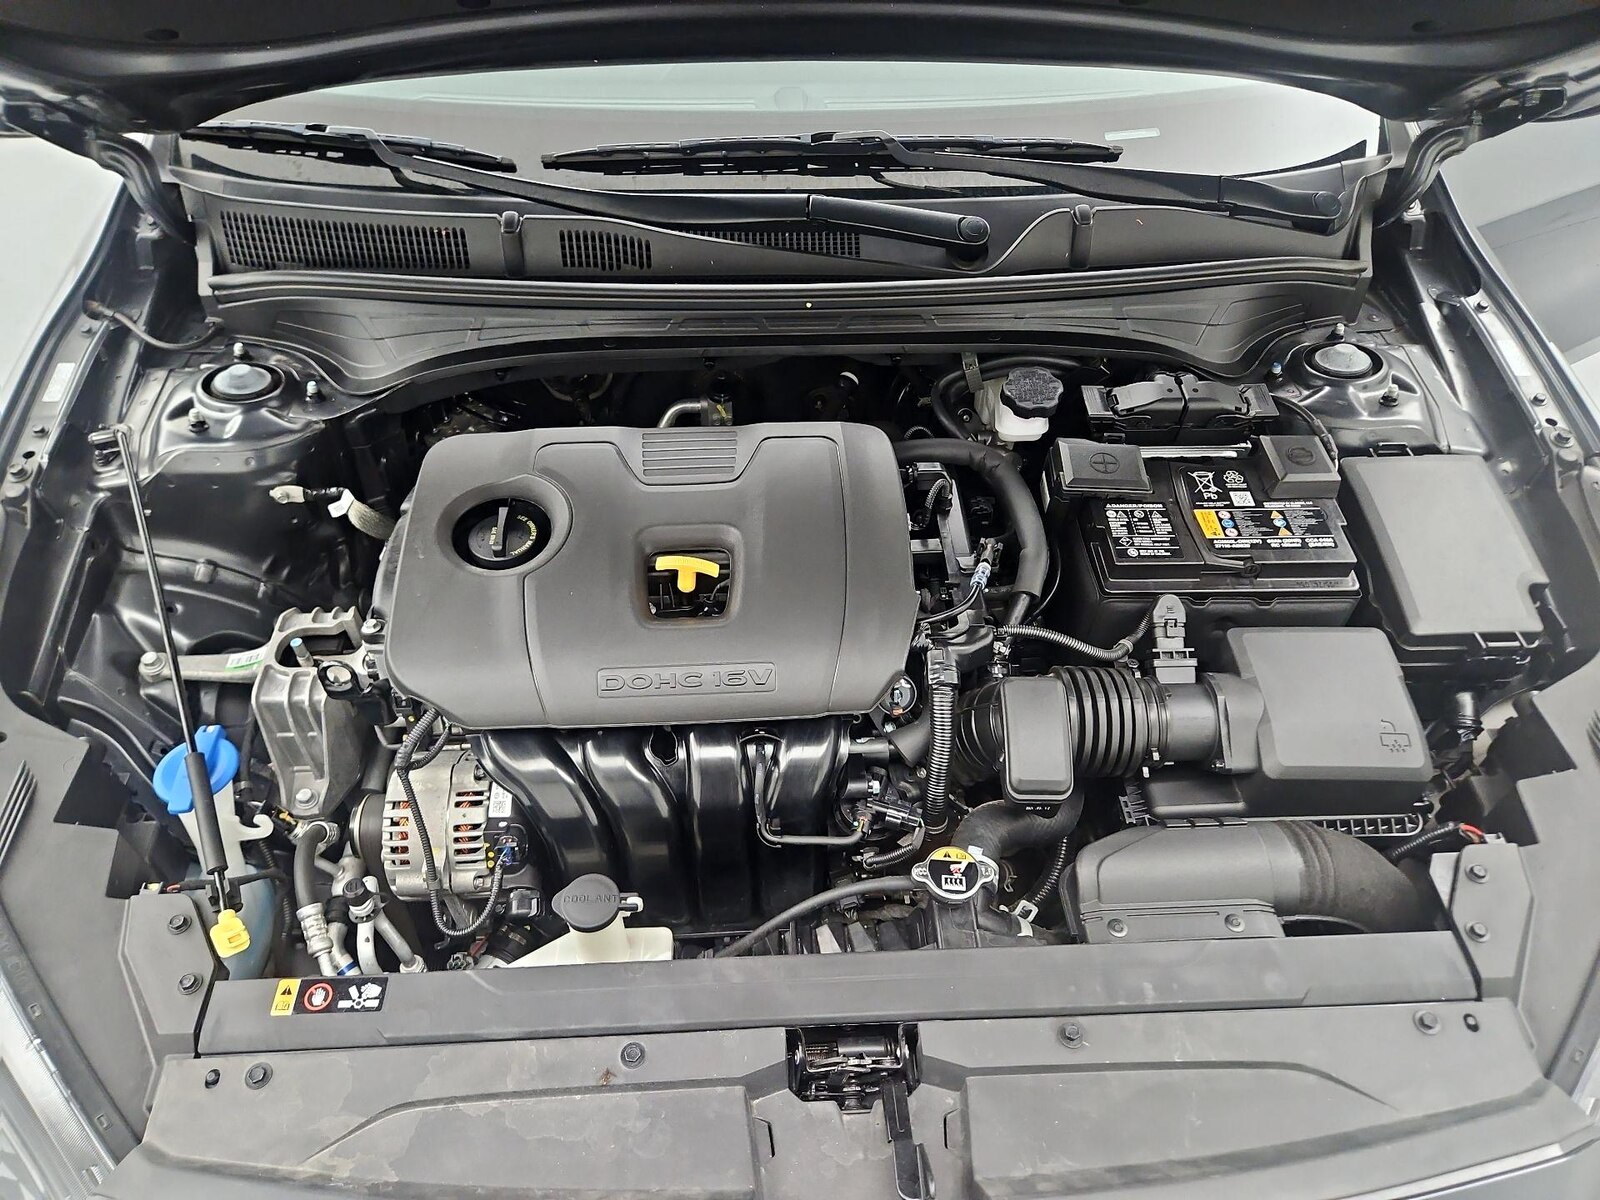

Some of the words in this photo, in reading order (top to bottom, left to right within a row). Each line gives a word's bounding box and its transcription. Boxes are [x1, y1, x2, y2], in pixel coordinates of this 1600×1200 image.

[1203, 492, 1218, 500] Pb
[600, 672, 703, 692] DOHC
[713, 668, 773, 688] 16V
[563, 893, 619, 904] COOLANT
